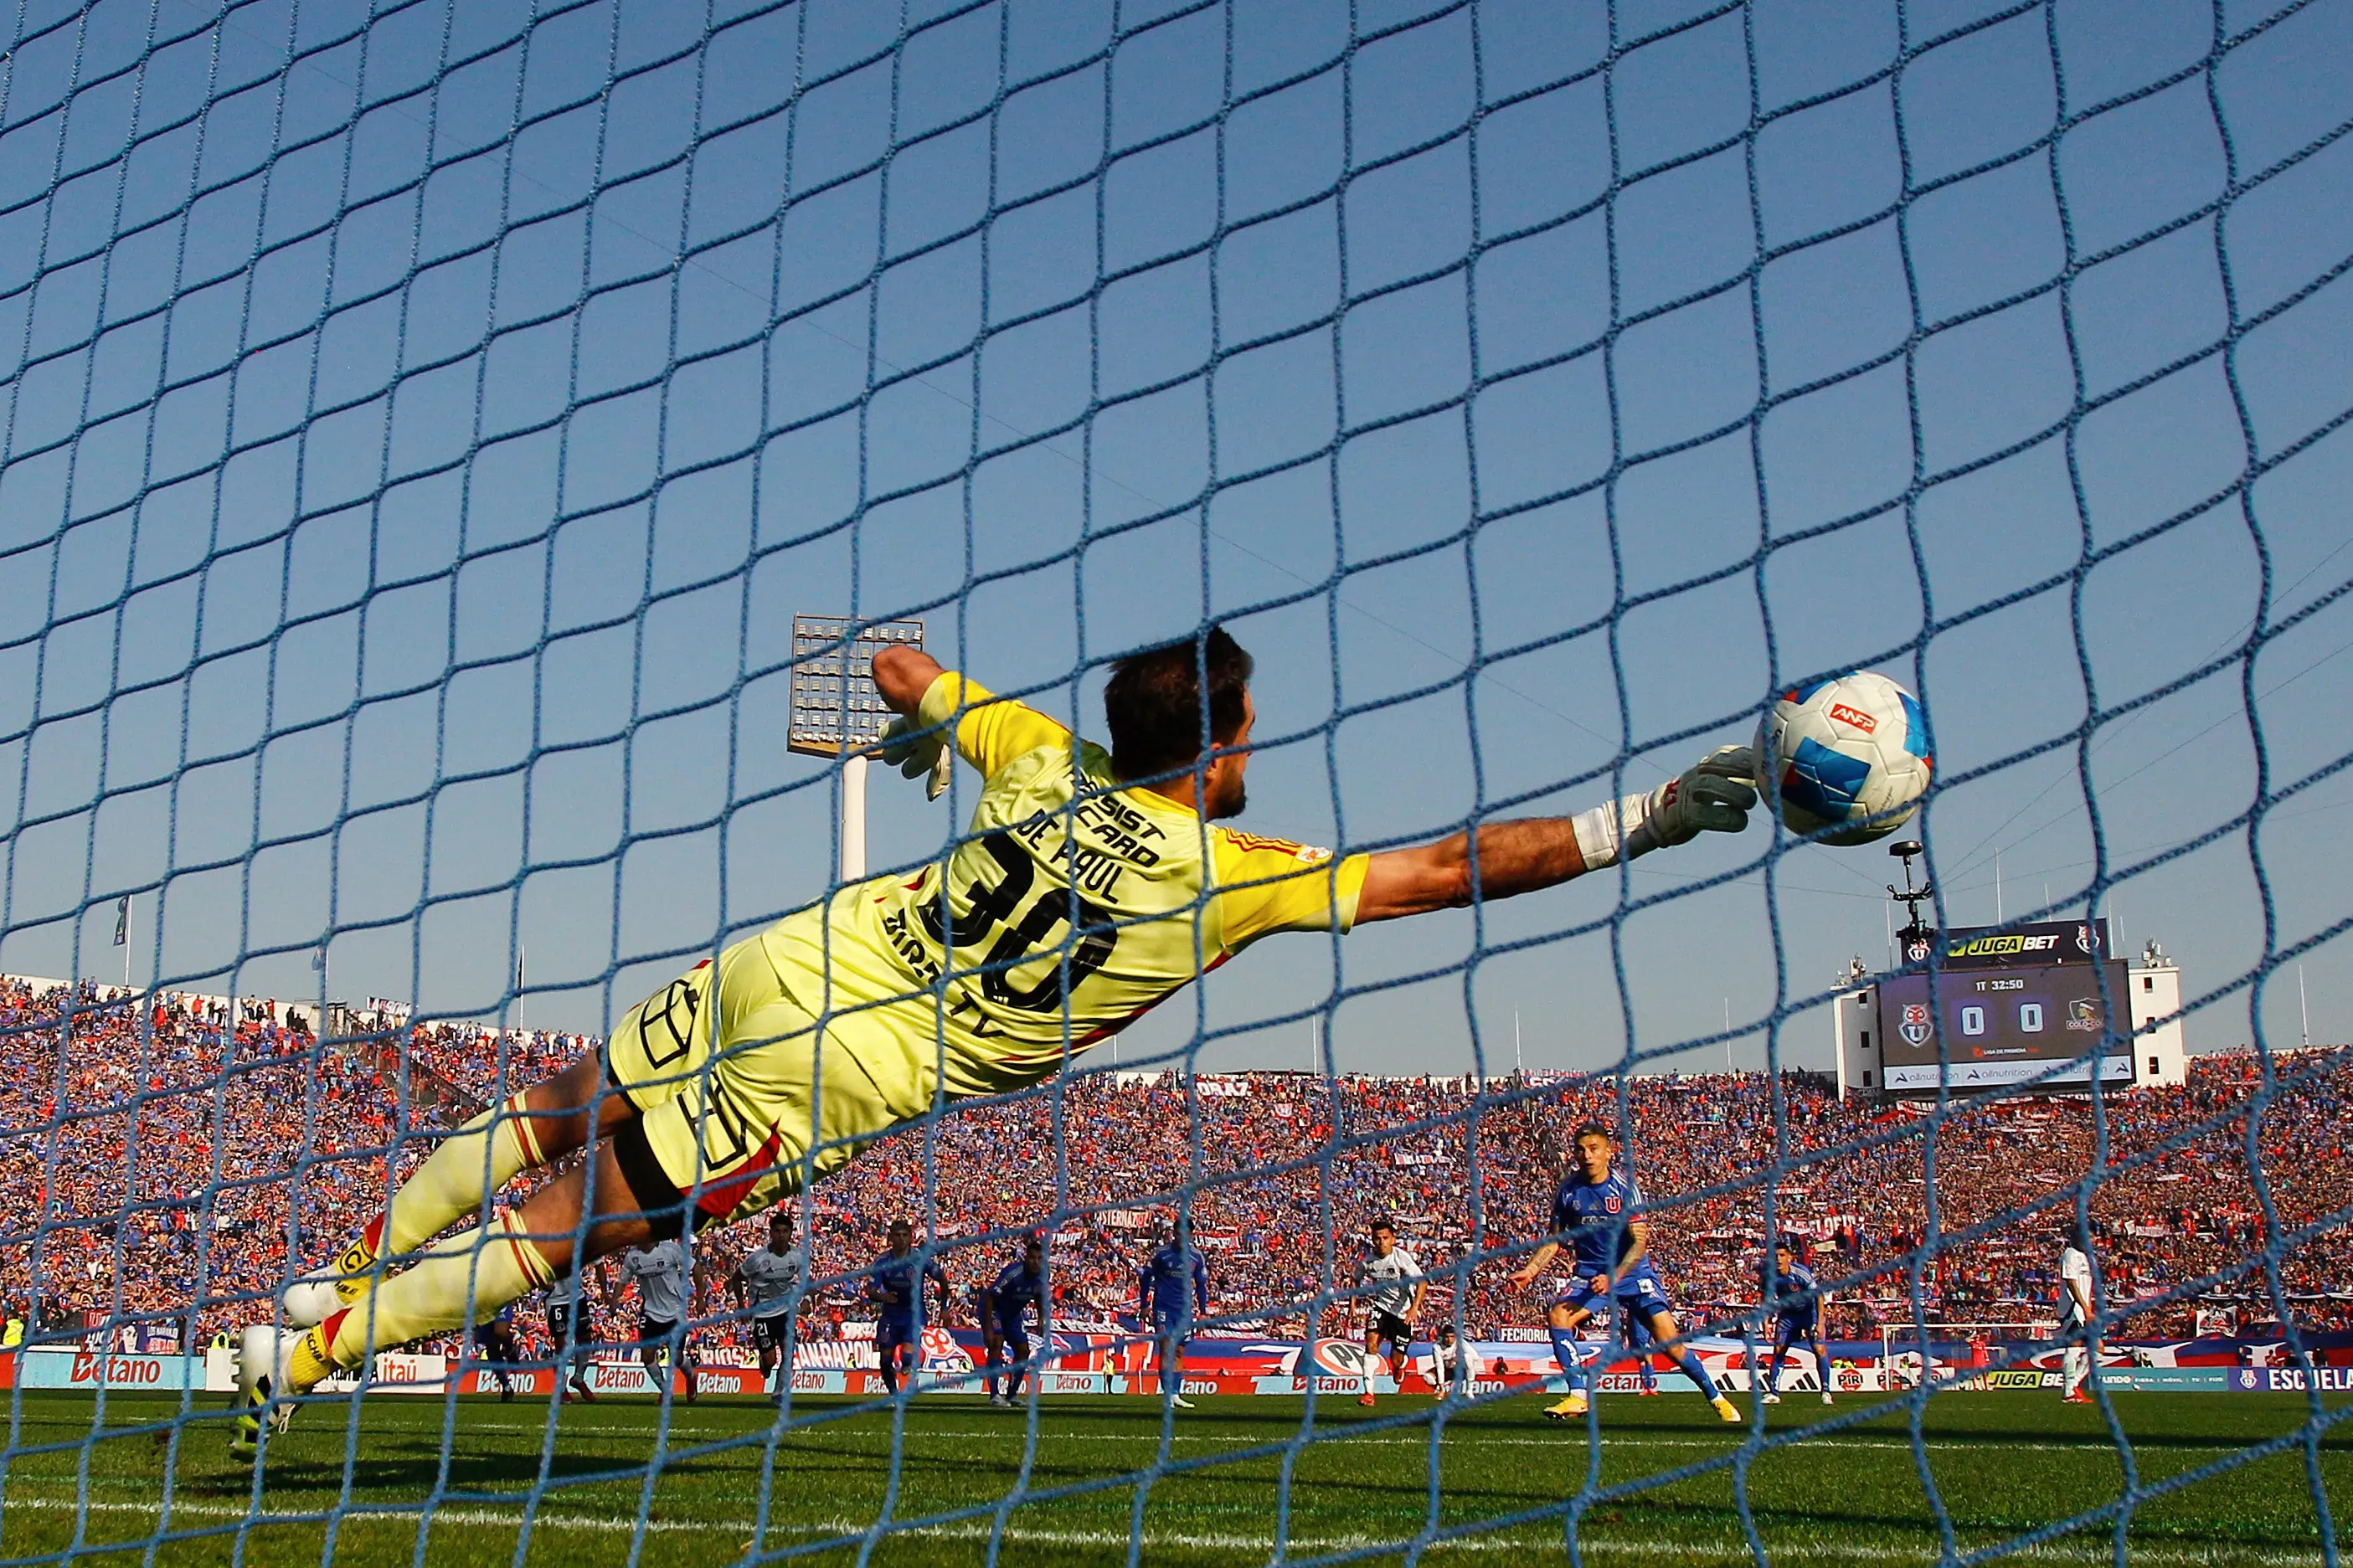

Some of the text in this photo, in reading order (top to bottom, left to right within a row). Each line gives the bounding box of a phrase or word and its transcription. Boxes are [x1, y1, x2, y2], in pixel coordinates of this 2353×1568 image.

[1832, 707, 1875, 728] ANFP
[1074, 805, 1161, 868] CARD
[1016, 808, 1123, 905] DE PAUL
[916, 835, 1118, 1014] 30
[1969, 934, 2060, 954] JUGABET
[1975, 979, 2024, 992] 1T 32:50
[1961, 1003, 2044, 1036] 0 0
[1908, 1072, 1959, 1082] allnutron
[1981, 1067, 2033, 1078] allnutrition
[1605, 1196, 1620, 1213] U
[554, 1308, 562, 1320] 6
[757, 1322, 769, 1335] 21
[1501, 1328, 1552, 1342] FECHORIA
[71, 1353, 161, 1383] Betano
[595, 1366, 646, 1388] Betano
[476, 1369, 535, 1393] Beano
[697, 1371, 741, 1393] Betano
[790, 1374, 826, 1390] etano
[1057, 1375, 1092, 1390] Betano
[1292, 1375, 1358, 1391] Btano
[1988, 1373, 2064, 1387] JUGABE
